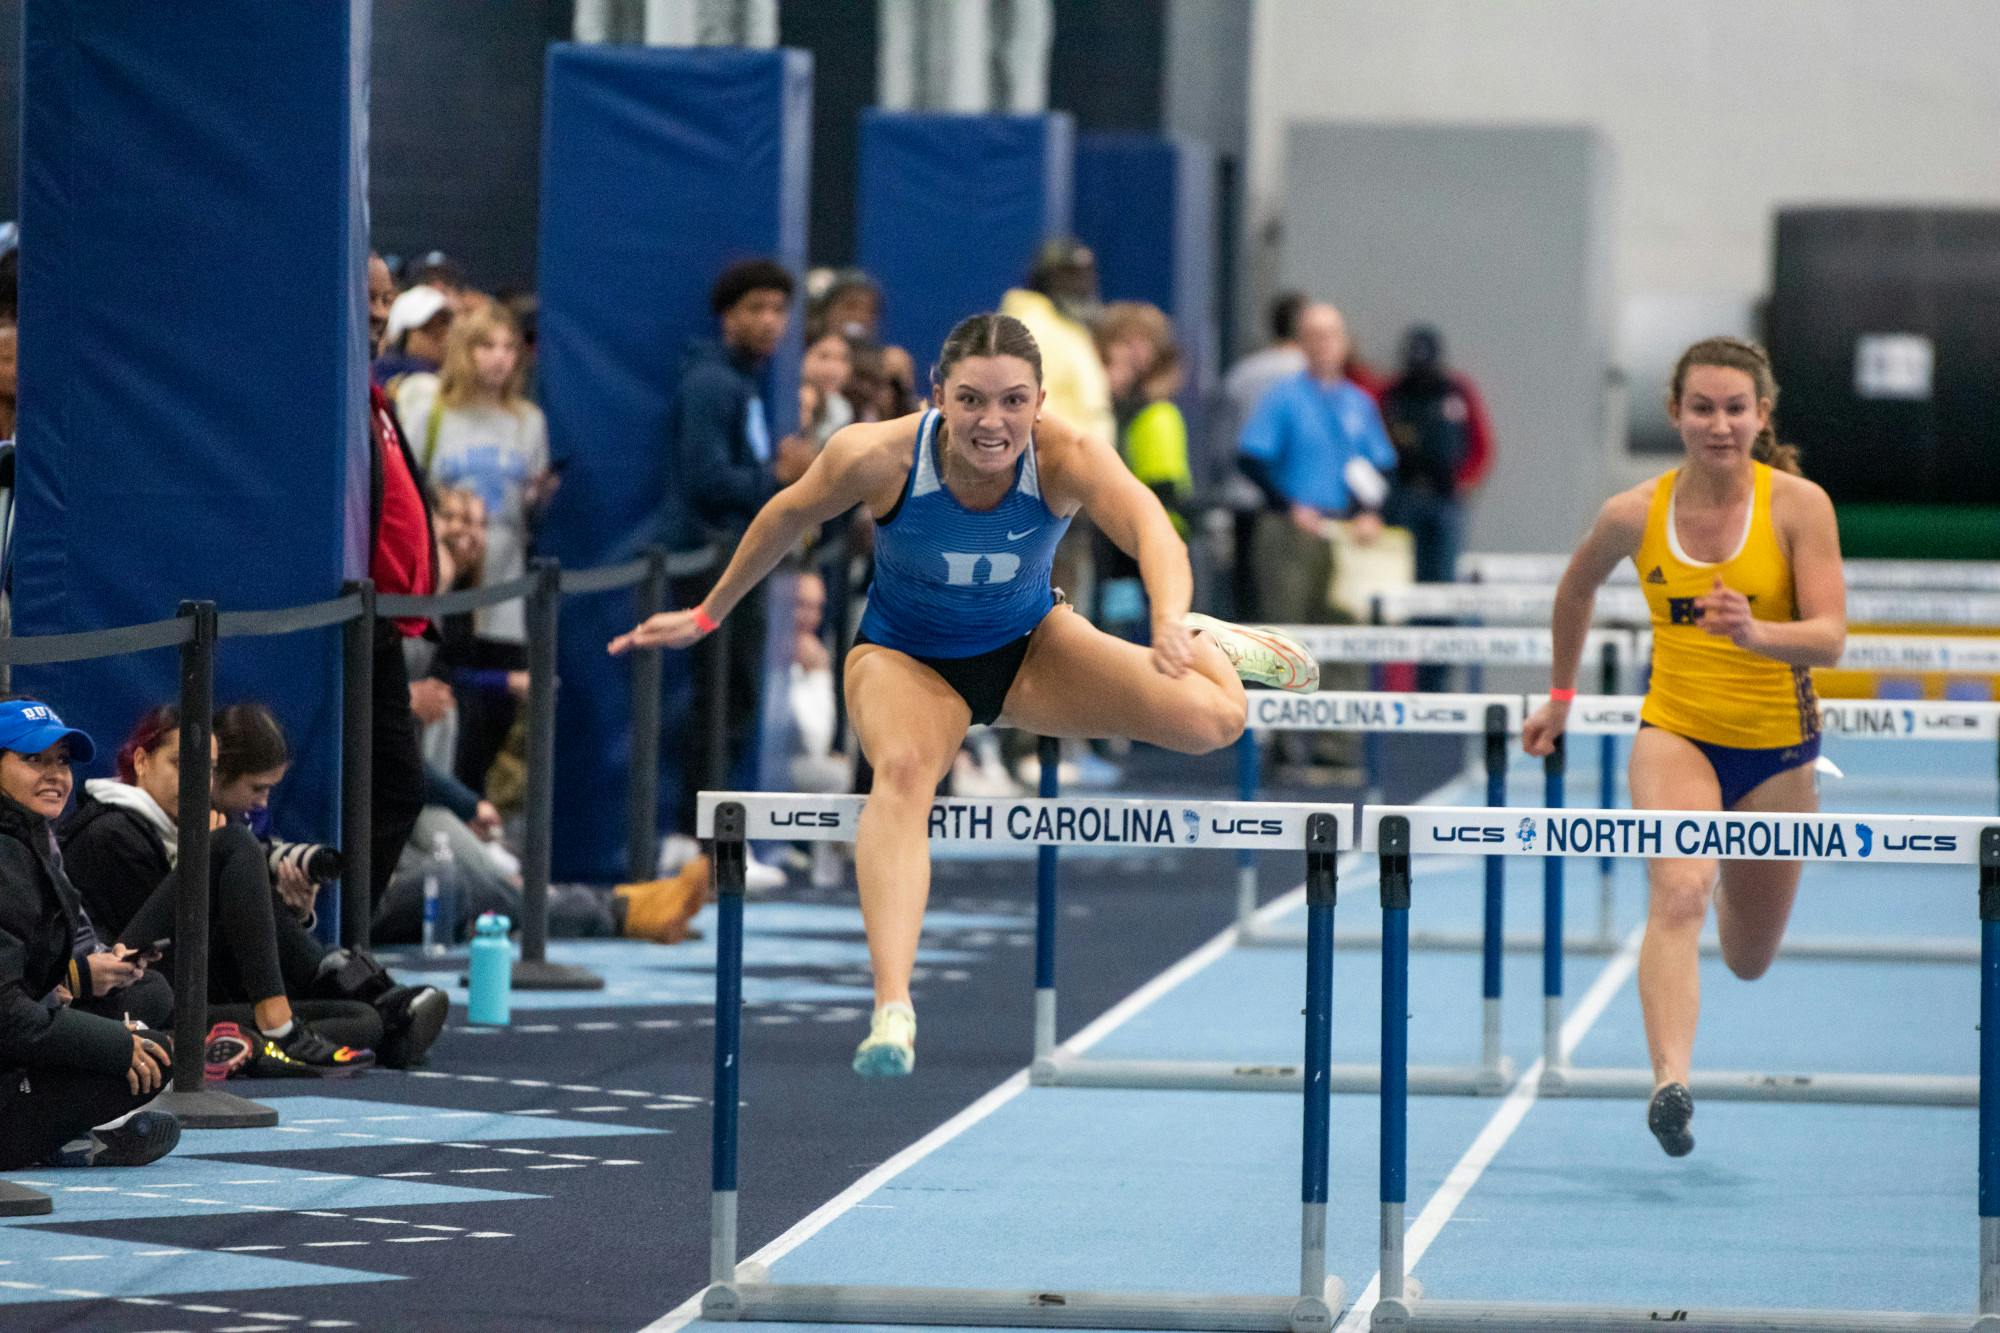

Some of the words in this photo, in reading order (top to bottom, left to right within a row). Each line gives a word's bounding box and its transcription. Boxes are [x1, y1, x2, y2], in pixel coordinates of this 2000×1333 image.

[1258, 698, 1387, 726] CAROLINA
[1412, 709, 1467, 722] UCS
[1583, 711, 1638, 723] UCS
[1823, 706, 1897, 733] OLINA
[1925, 715, 1979, 729] UCS
[770, 811, 841, 828] UCS
[928, 804, 993, 840] RTH
[1007, 804, 1175, 844] CAROLINA
[1212, 818, 1284, 836] UCS
[1433, 825, 1505, 843] UCS
[1546, 817, 1662, 854] NORTH
[1674, 819, 1848, 858] CAROLINA
[1883, 833, 1957, 852] UCS
